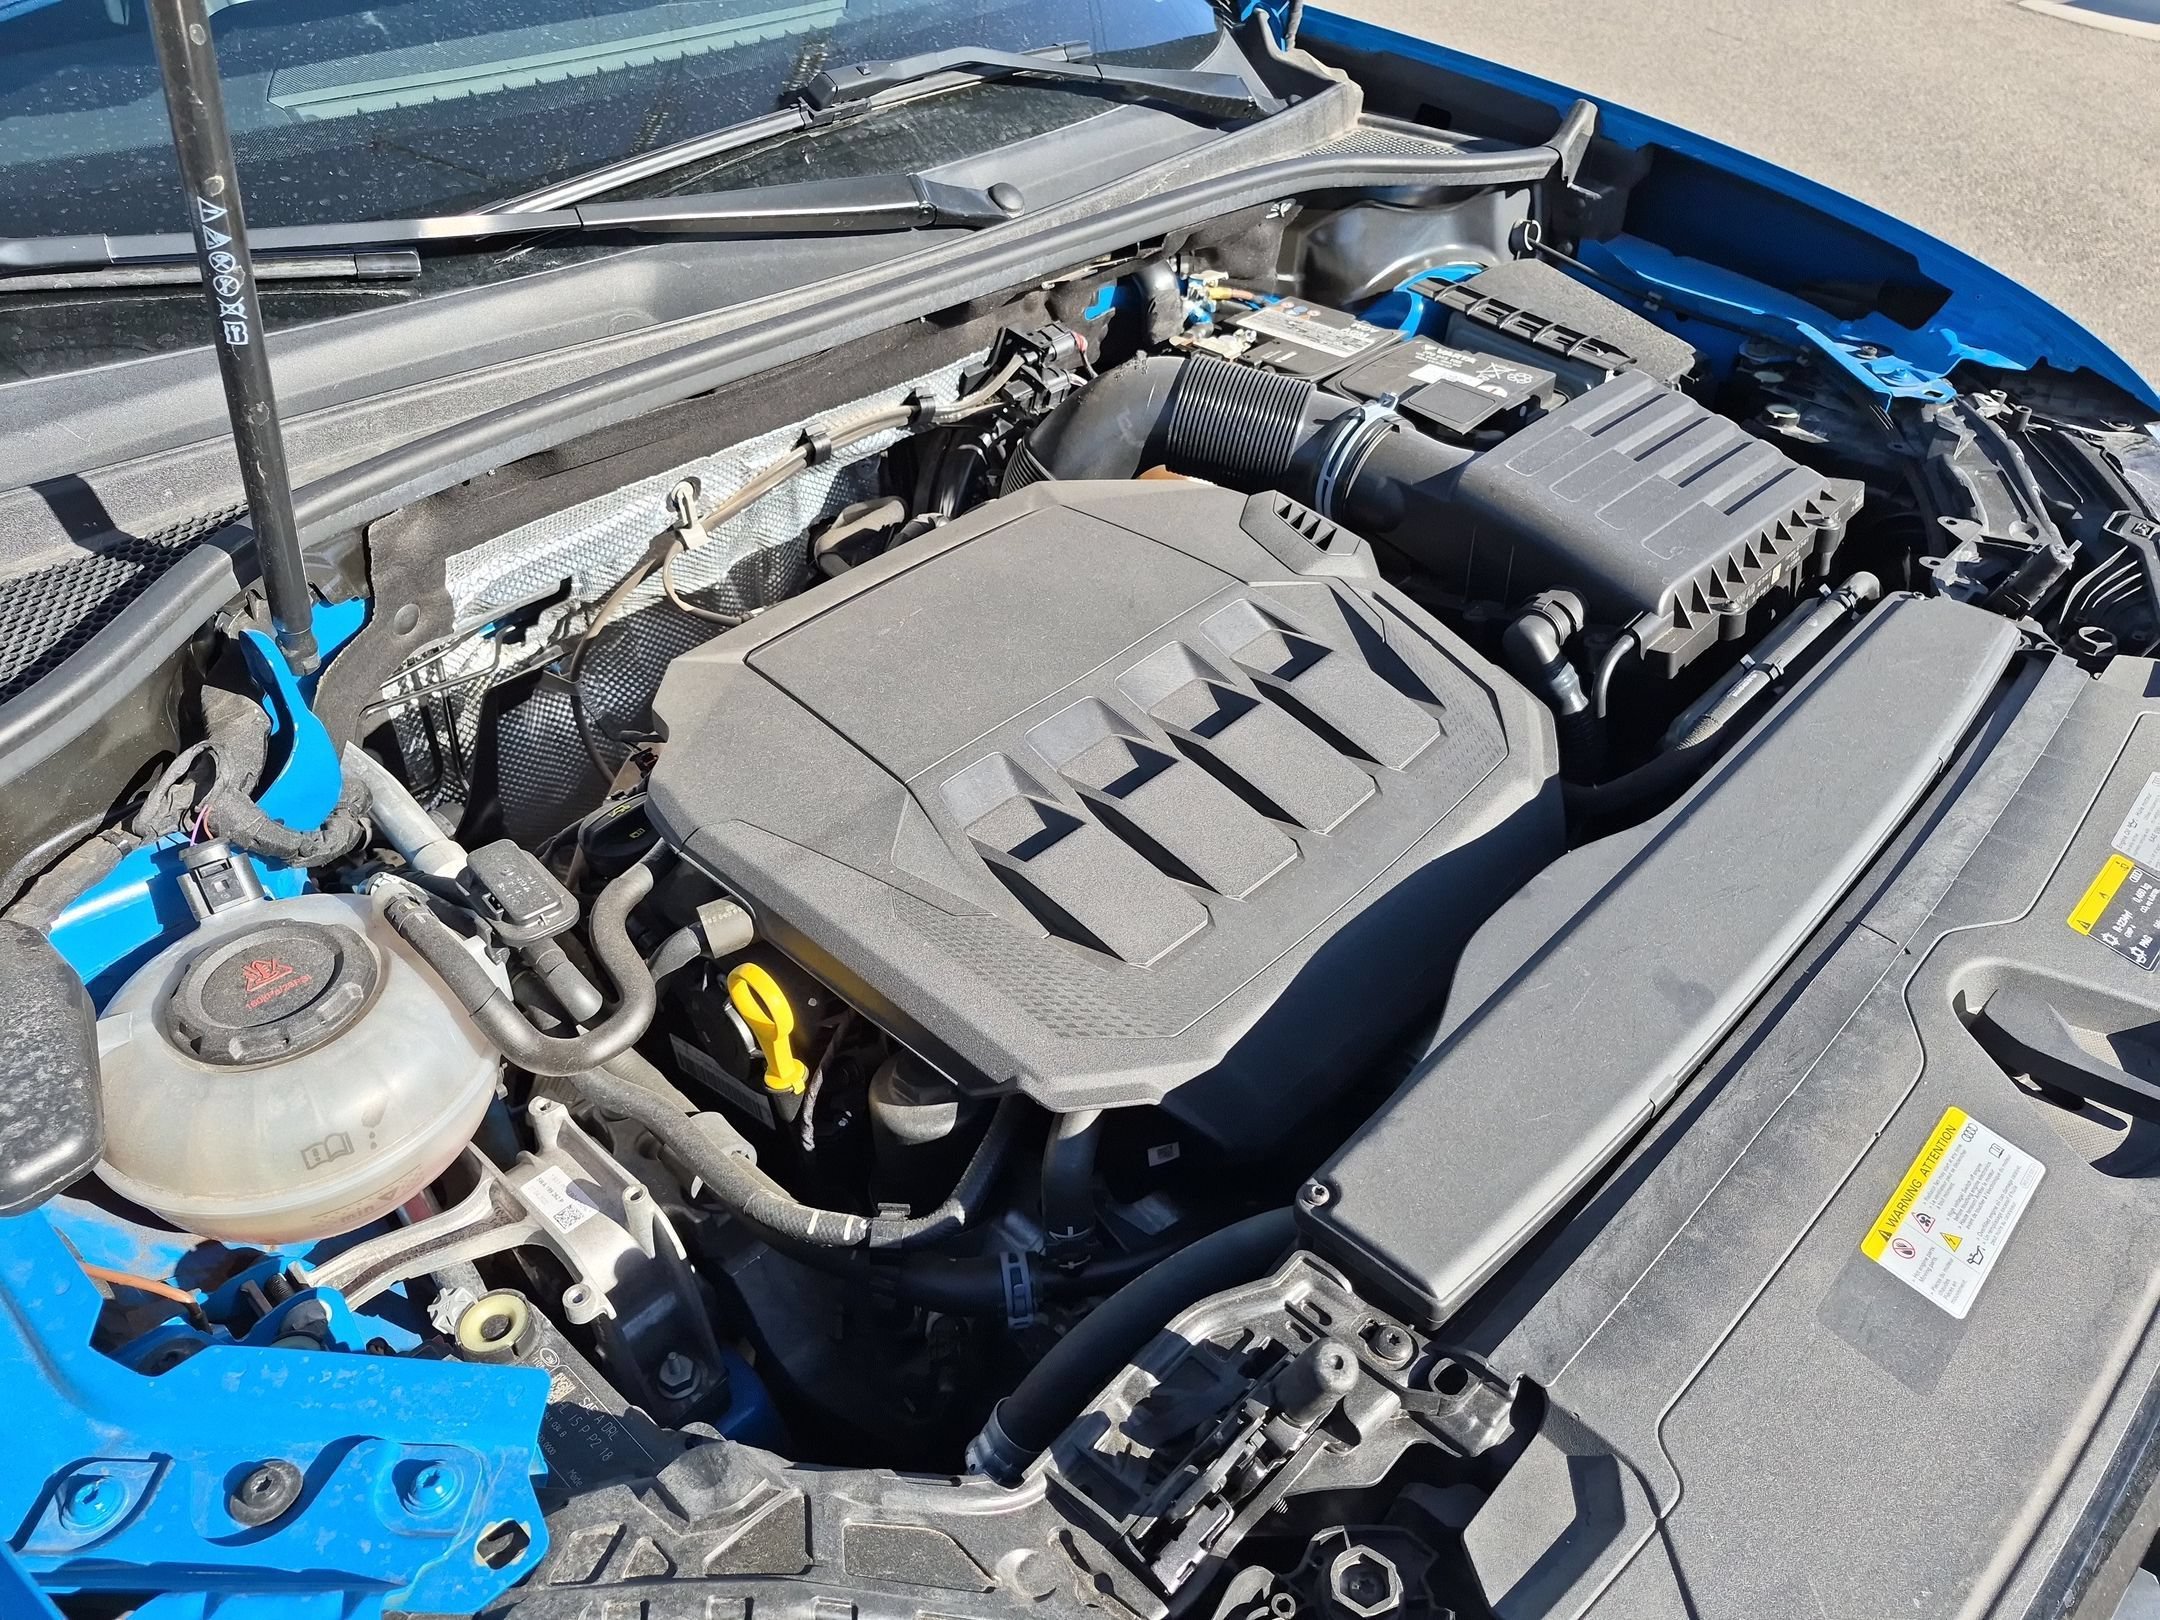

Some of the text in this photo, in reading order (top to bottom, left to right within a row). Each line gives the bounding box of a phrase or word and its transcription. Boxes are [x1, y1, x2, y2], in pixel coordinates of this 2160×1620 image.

[1437, 348, 1477, 364] VARTA
[2116, 835, 2128, 849] Engine
[2112, 909, 2133, 933] R-1234yf
[2140, 883, 2152, 891] kg
[2139, 935, 2153, 948] PAG
[1886, 1125, 1956, 1227] WARNING ATTENTION
[341, 1205, 374, 1223] min
[1947, 1208, 1957, 1217] High
[1912, 1270, 1921, 1279] Hot
[1918, 1257, 1929, 1271] engine
[1918, 1267, 1932, 1282] Moving
[579, 1396, 619, 1441] SAE A DRL
[581, 1424, 591, 1433] P
[586, 1433, 601, 1448] P2
[600, 1448, 613, 1461] 18
[567, 1469, 583, 1487] Made
